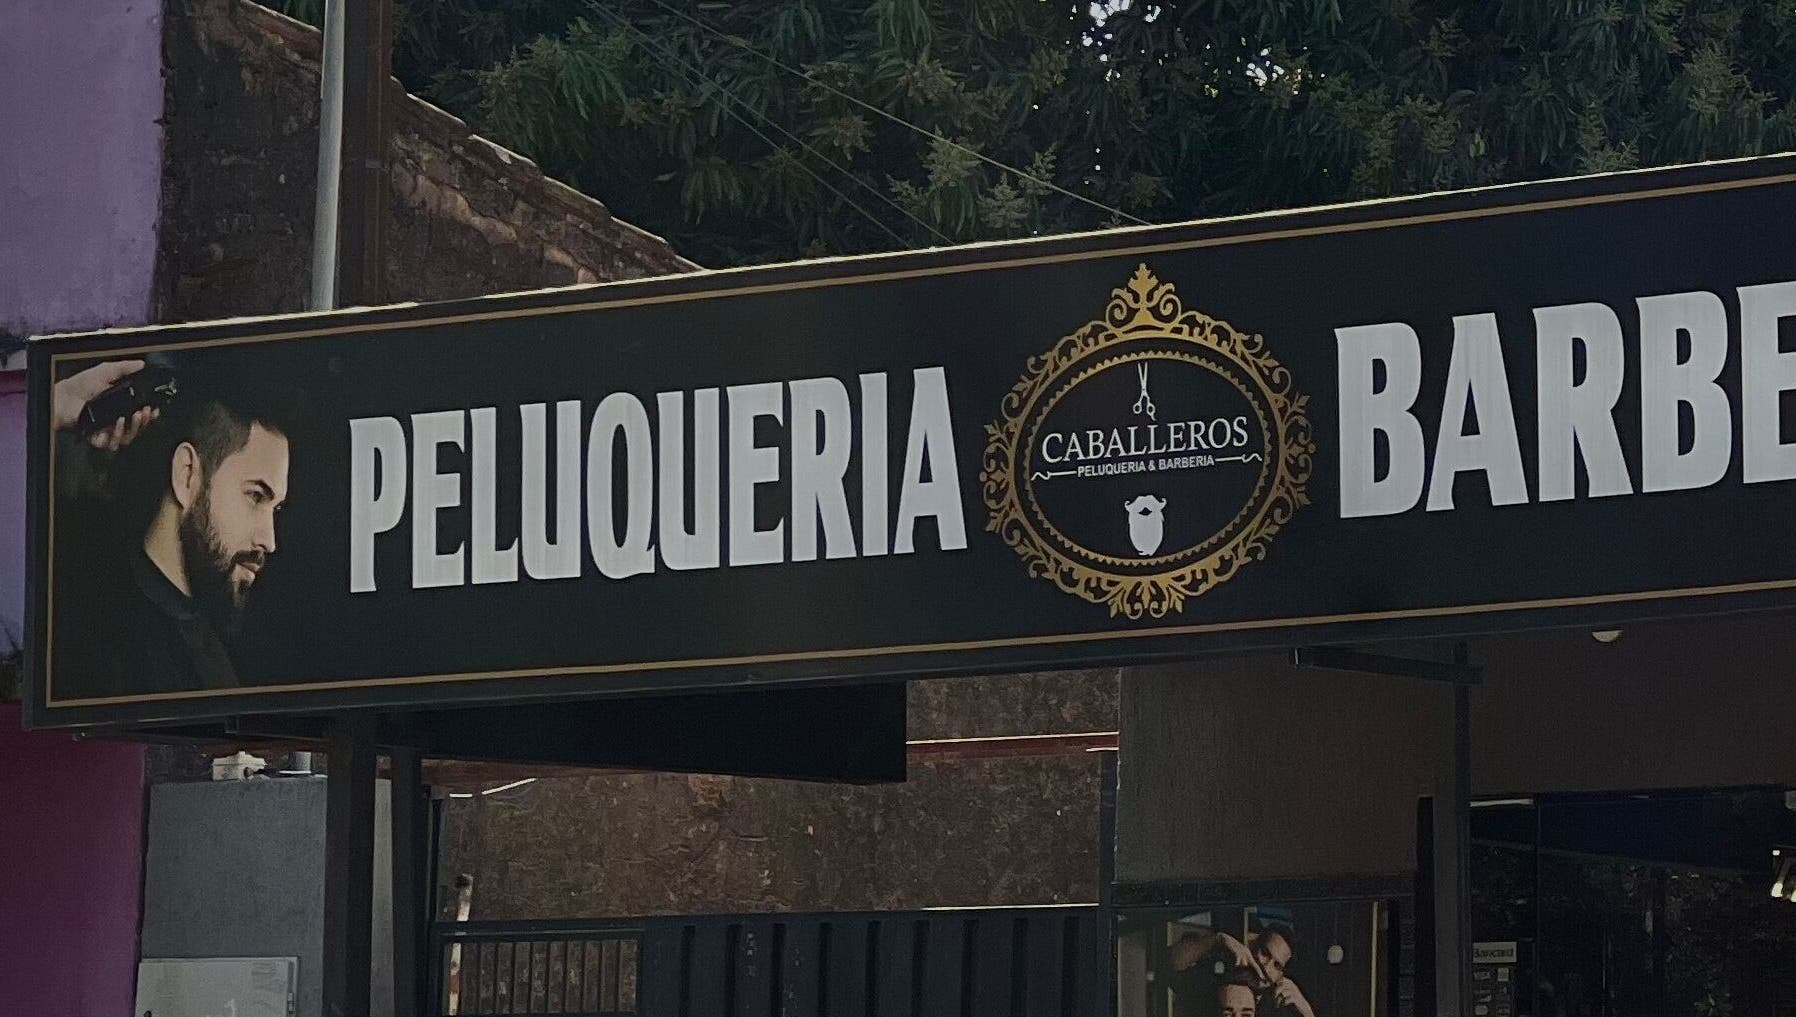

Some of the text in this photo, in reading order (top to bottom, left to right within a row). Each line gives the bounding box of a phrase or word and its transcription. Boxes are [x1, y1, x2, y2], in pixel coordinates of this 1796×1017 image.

[1041, 415, 1249, 464] CABALLEROS
[349, 366, 968, 593] PELUQUERIA
[1077, 455, 1214, 477] PELUQUERIA & BARBERIA
